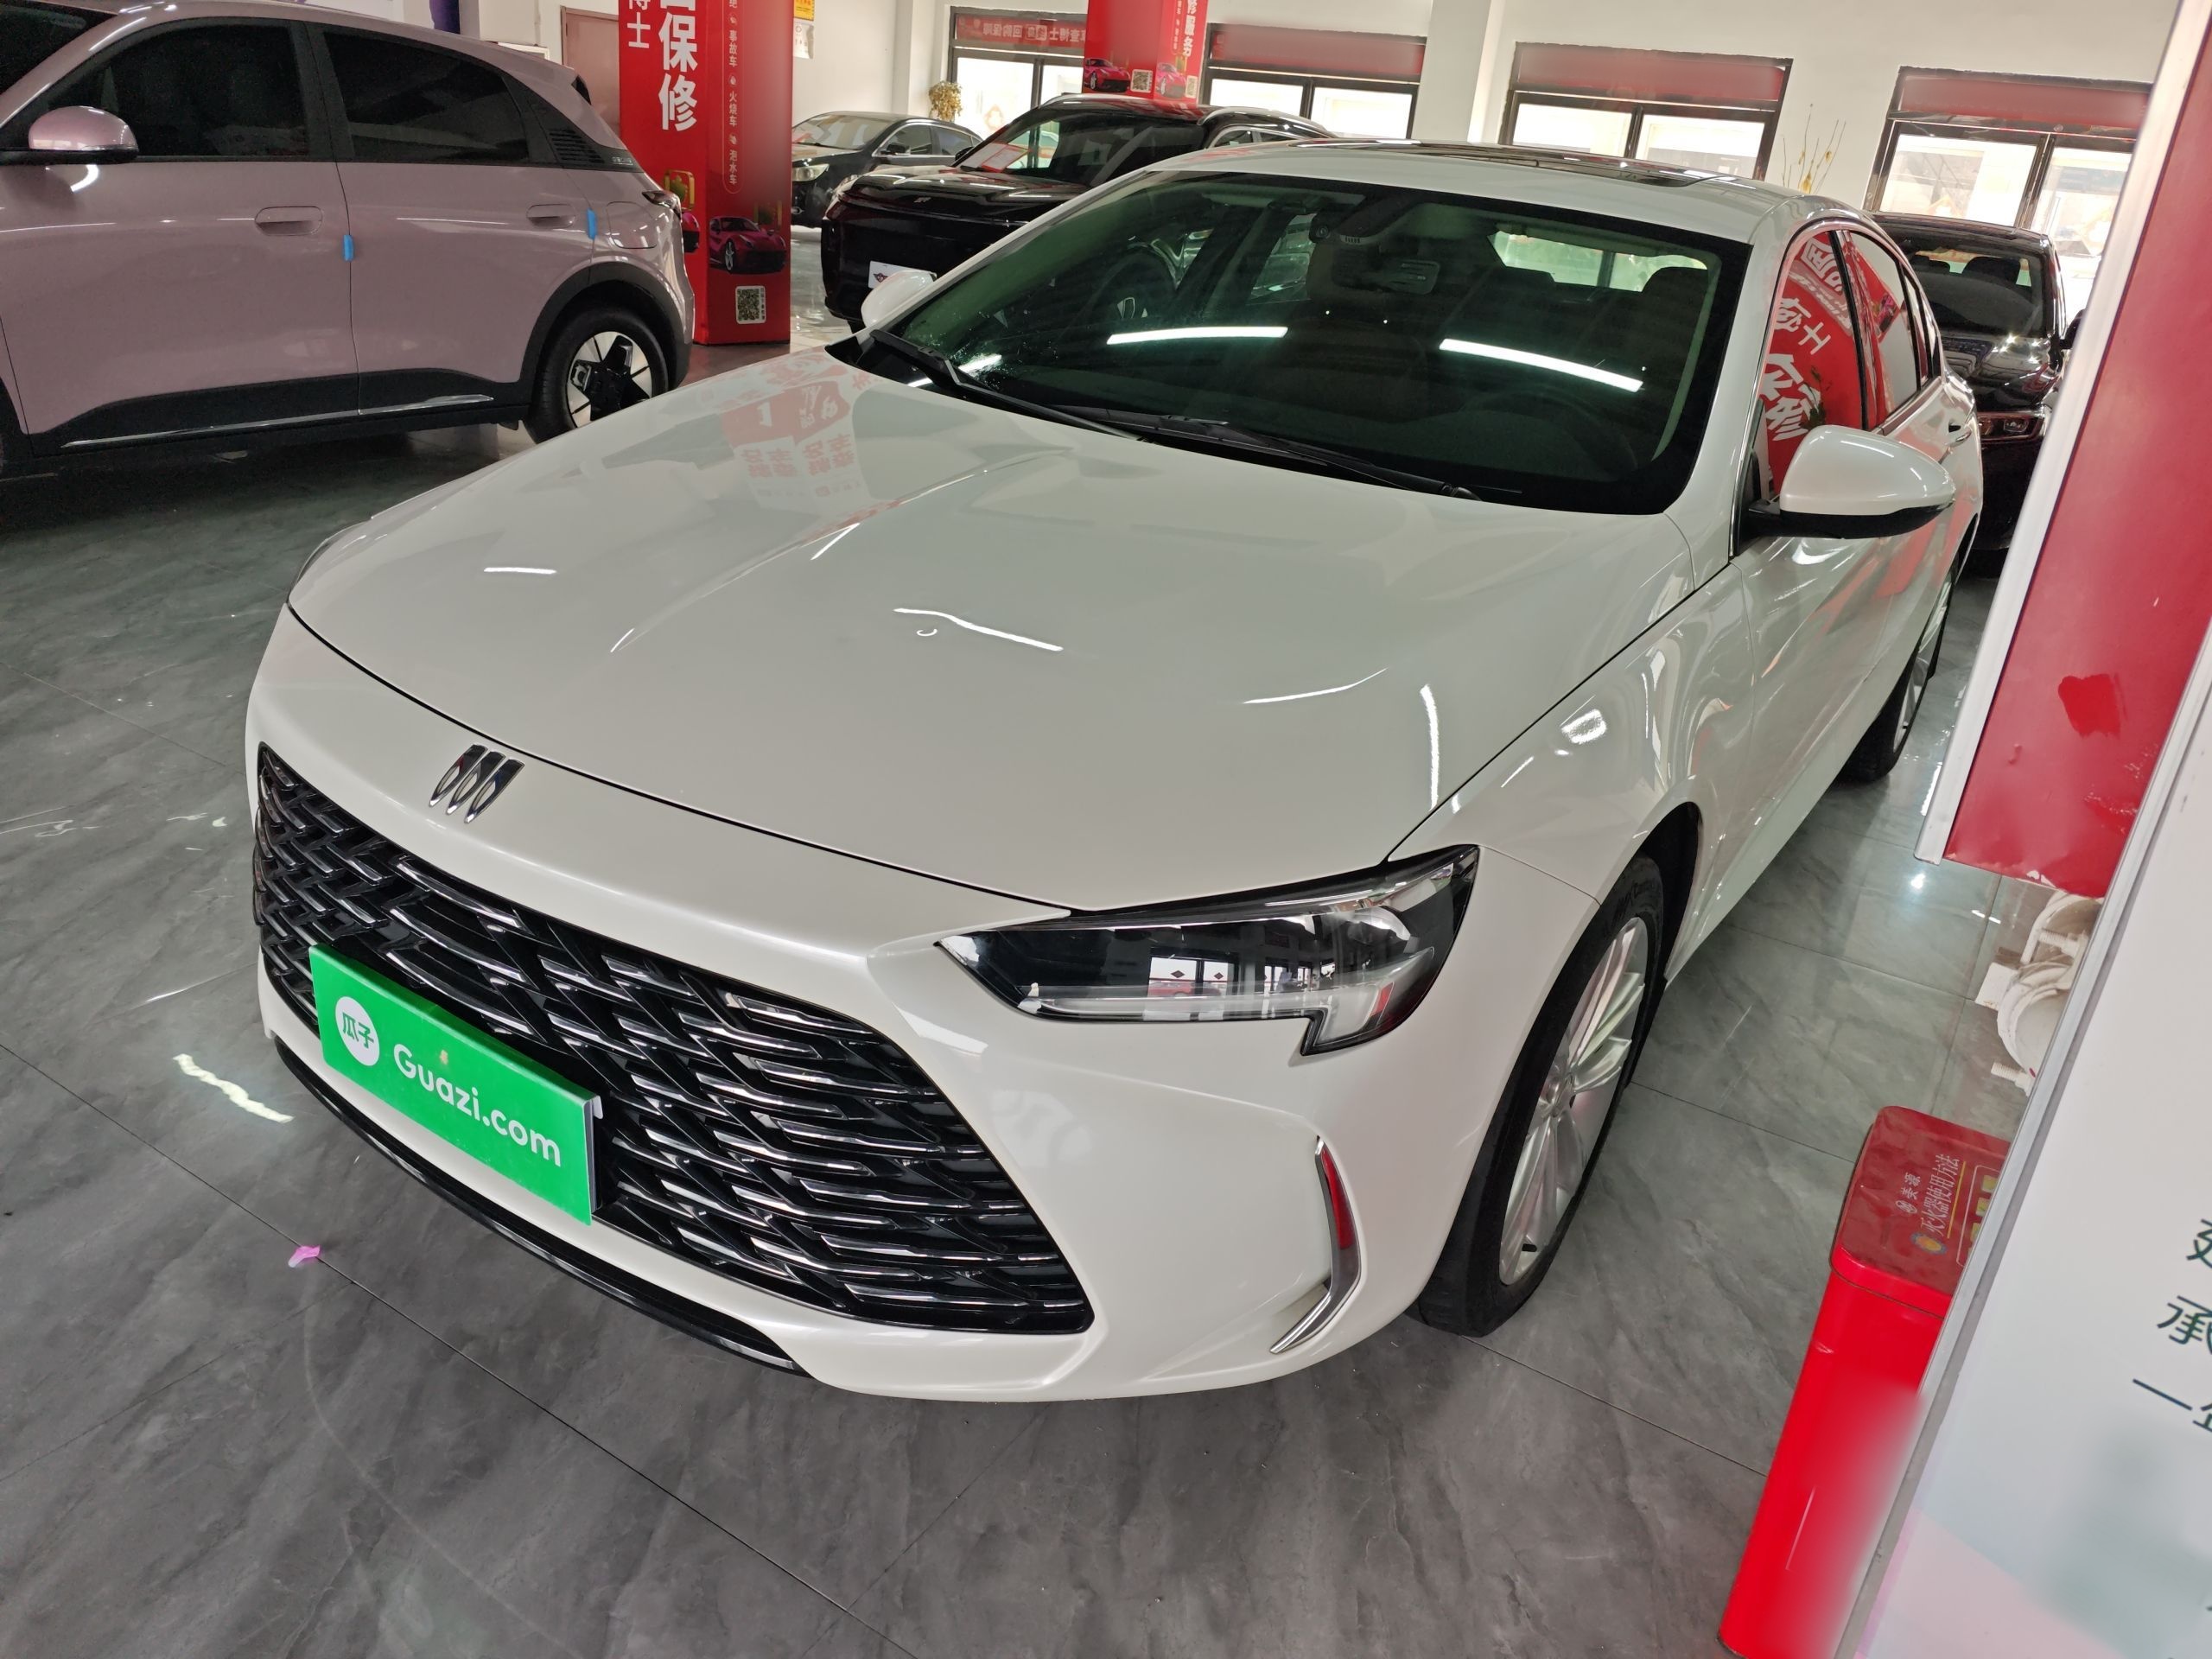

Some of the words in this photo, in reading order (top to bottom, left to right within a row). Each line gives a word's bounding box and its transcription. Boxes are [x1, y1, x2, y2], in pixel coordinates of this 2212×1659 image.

[626, 0, 652, 48] 士
[658, 0, 698, 132] 保修
[728, 29, 739, 68] 事故车
[728, 91, 739, 127] 火烧车
[728, 149, 739, 185] 泡水车
[342, 1012, 374, 1049] 瓜子
[393, 1043, 561, 1166] Guazi.com
[1920, 1154, 1961, 1237] 灭火器使用方法
